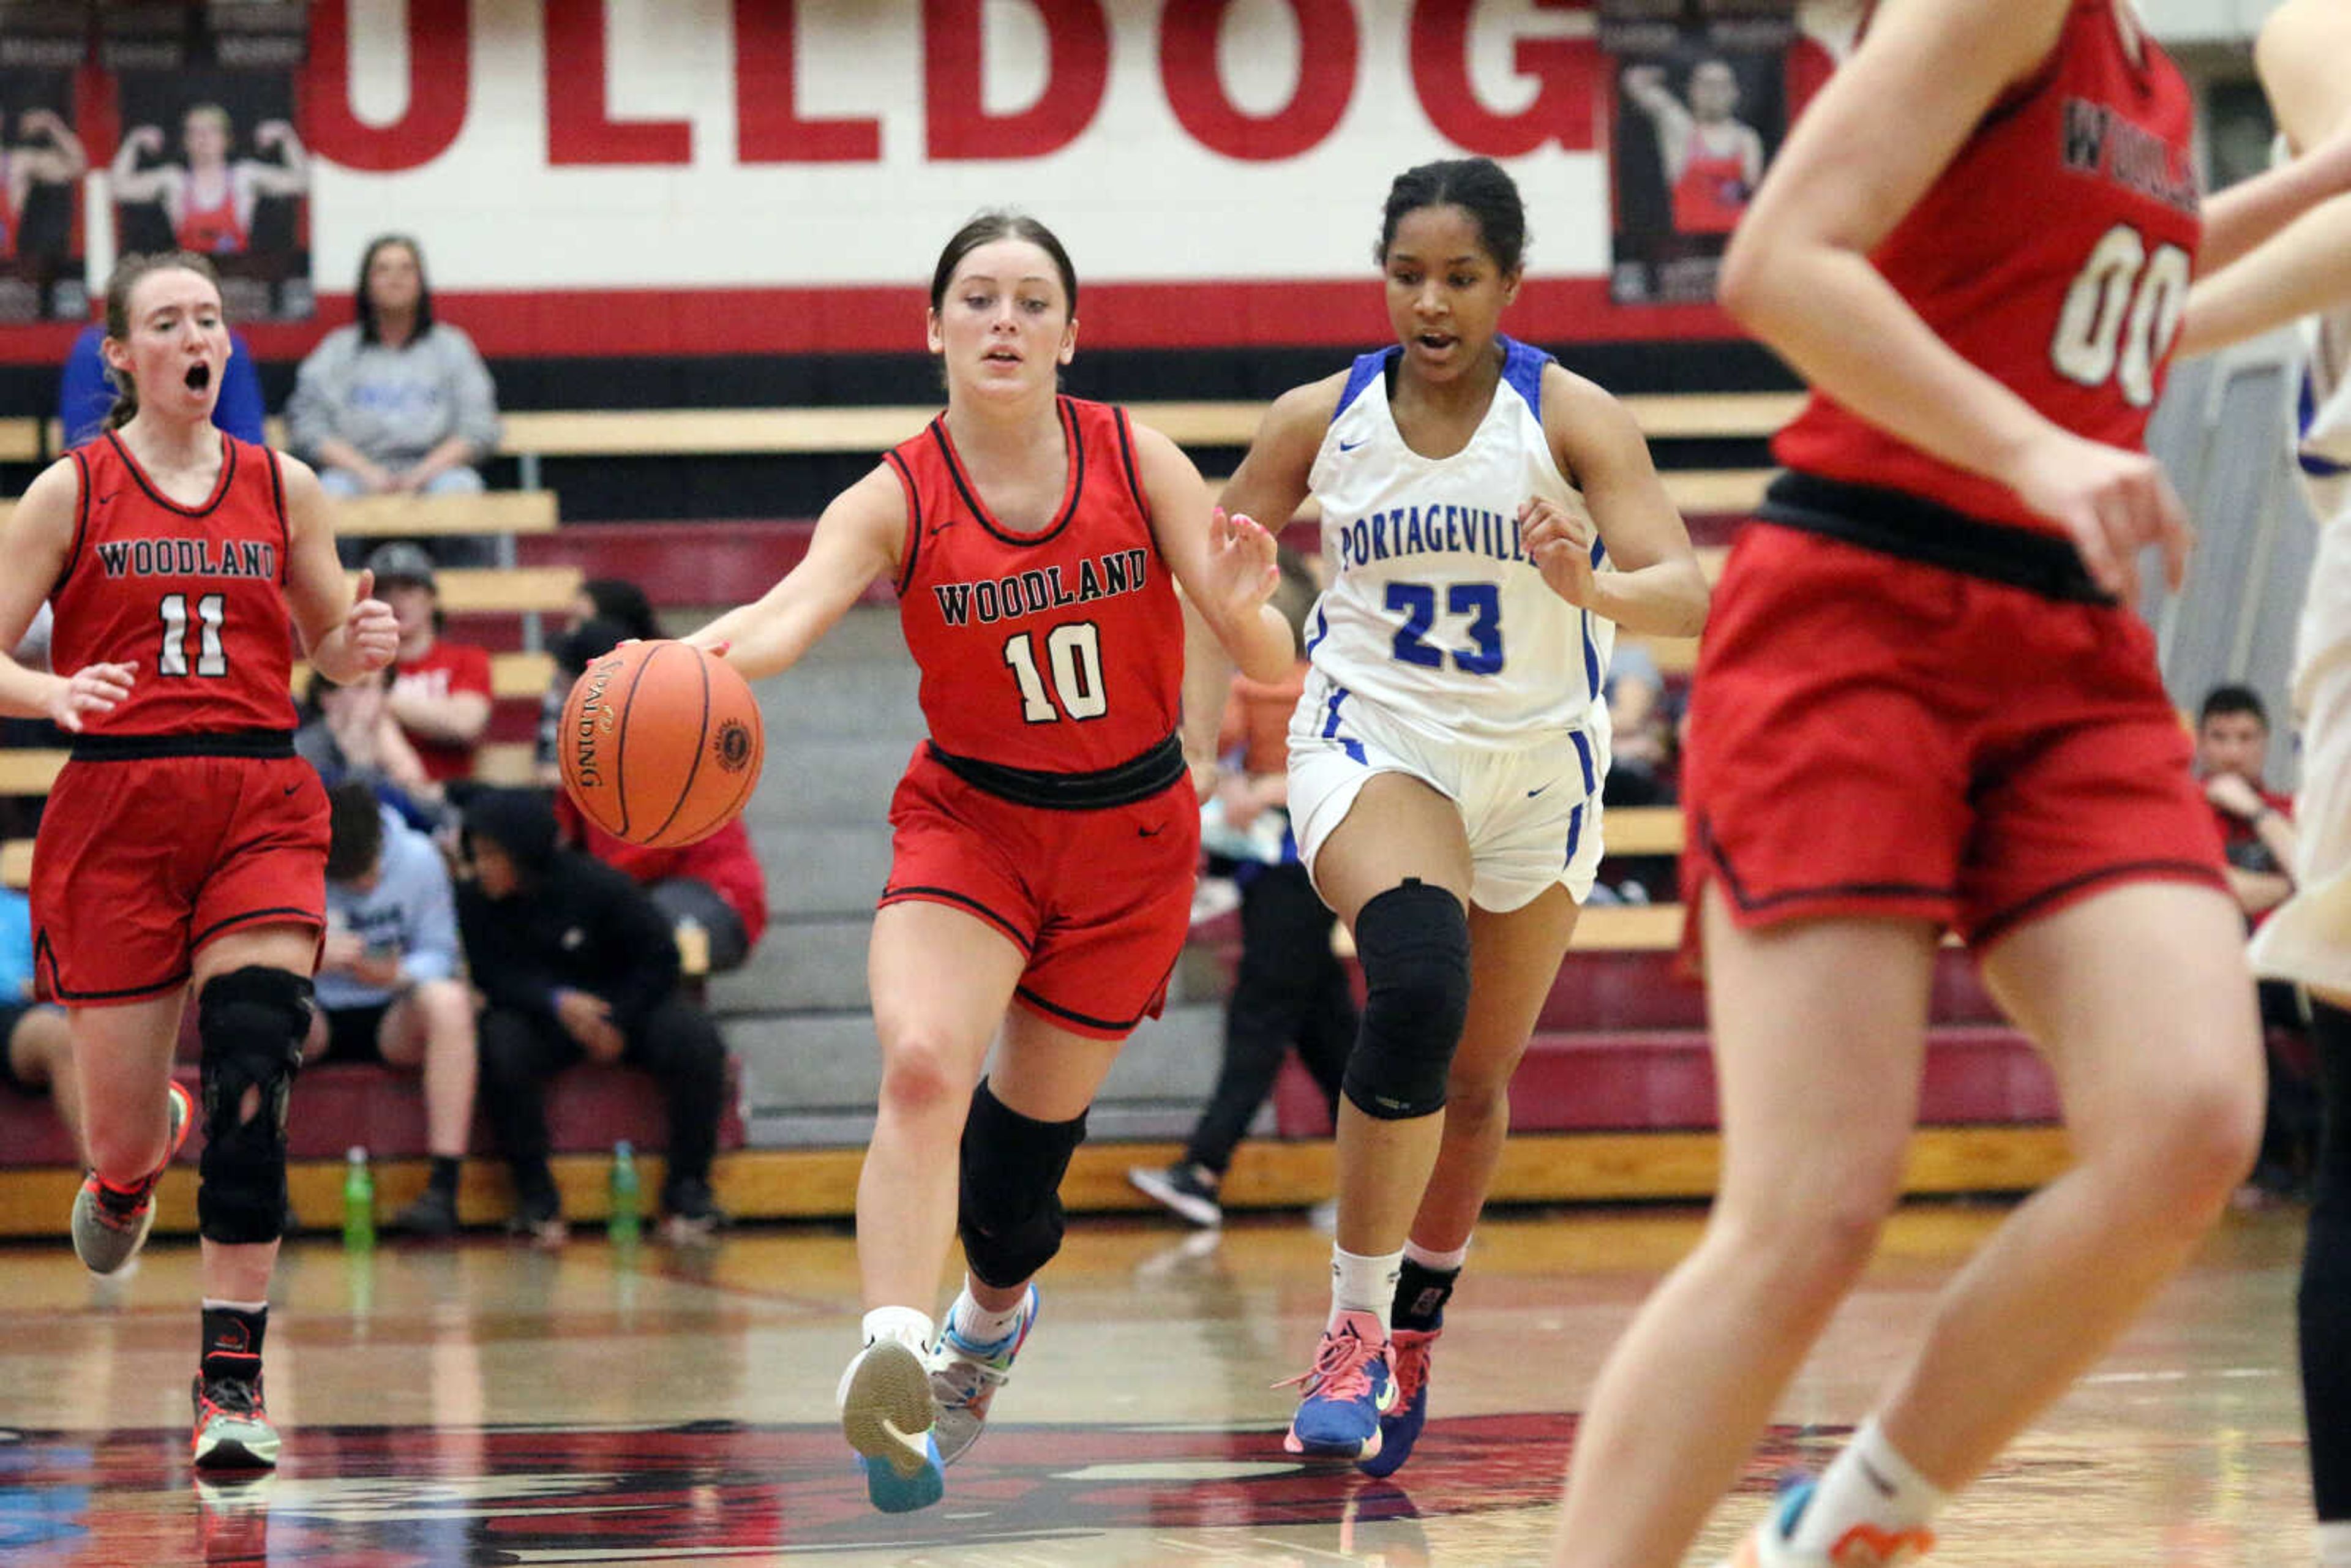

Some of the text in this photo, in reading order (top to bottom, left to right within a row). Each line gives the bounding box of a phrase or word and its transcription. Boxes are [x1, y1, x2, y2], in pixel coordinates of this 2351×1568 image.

[298, 0, 1840, 167] ULLDOG
[2050, 223, 2191, 407] 00
[97, 539, 276, 579] WOODLAND
[1340, 504, 1539, 571] PORTAGEVILL
[932, 549, 1148, 626] WOODLAND
[1384, 580, 1504, 676] 23
[158, 593, 227, 677] 11
[1002, 620, 1107, 724] 10
